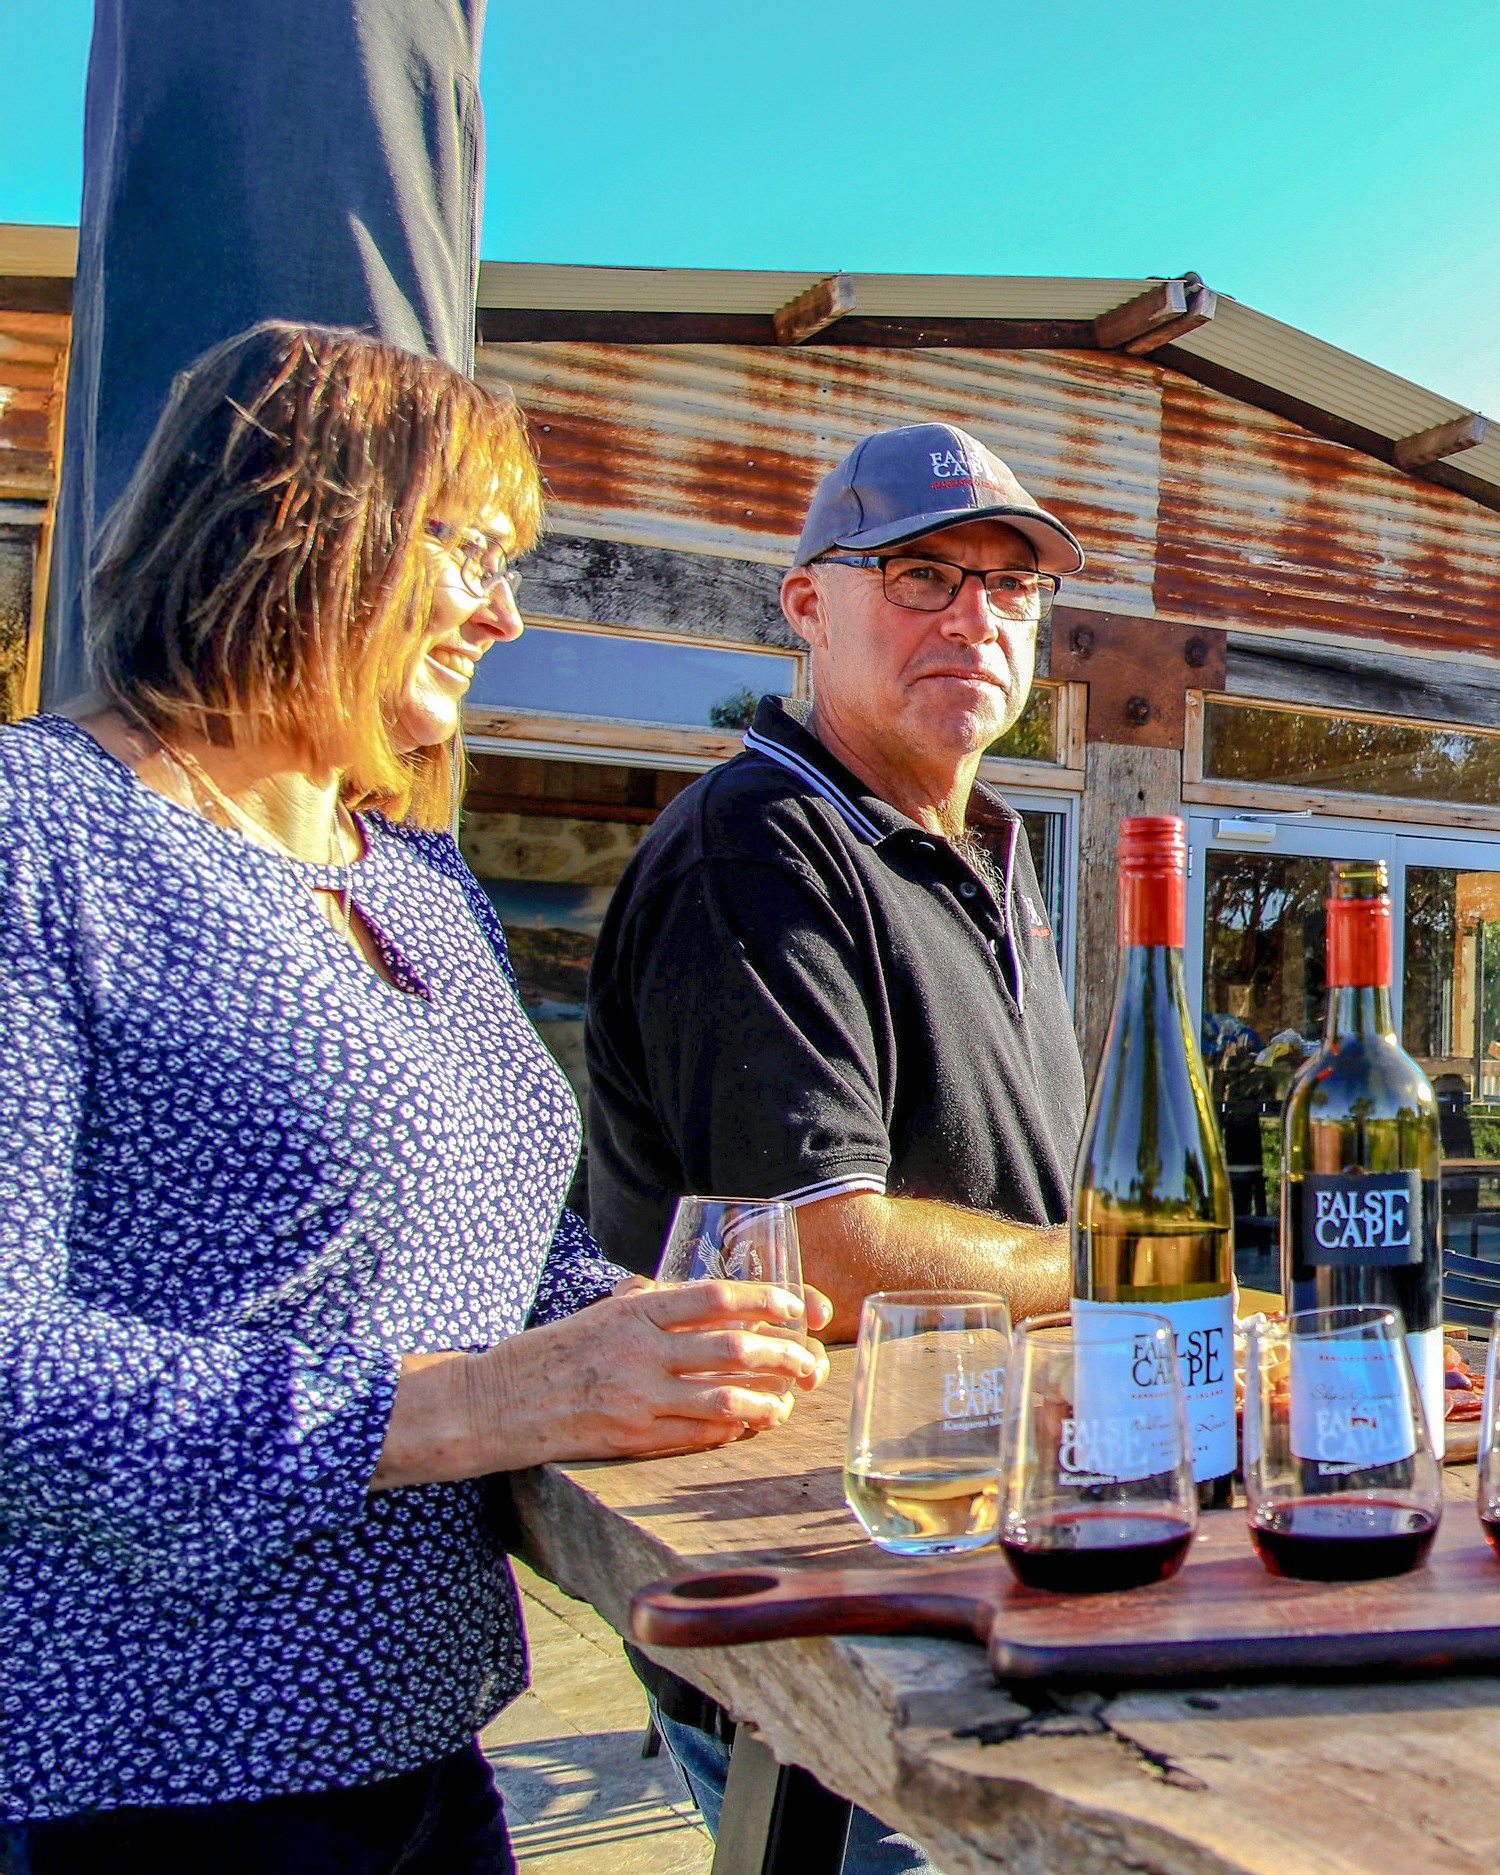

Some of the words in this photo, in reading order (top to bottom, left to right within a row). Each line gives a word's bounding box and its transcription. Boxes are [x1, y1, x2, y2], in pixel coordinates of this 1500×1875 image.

[1314, 1190, 1411, 1225] FALSE
[1314, 1213, 1411, 1249] CAPE
[944, 1368, 1005, 1397] FALSE
[943, 1387, 1005, 1418] CAPE
